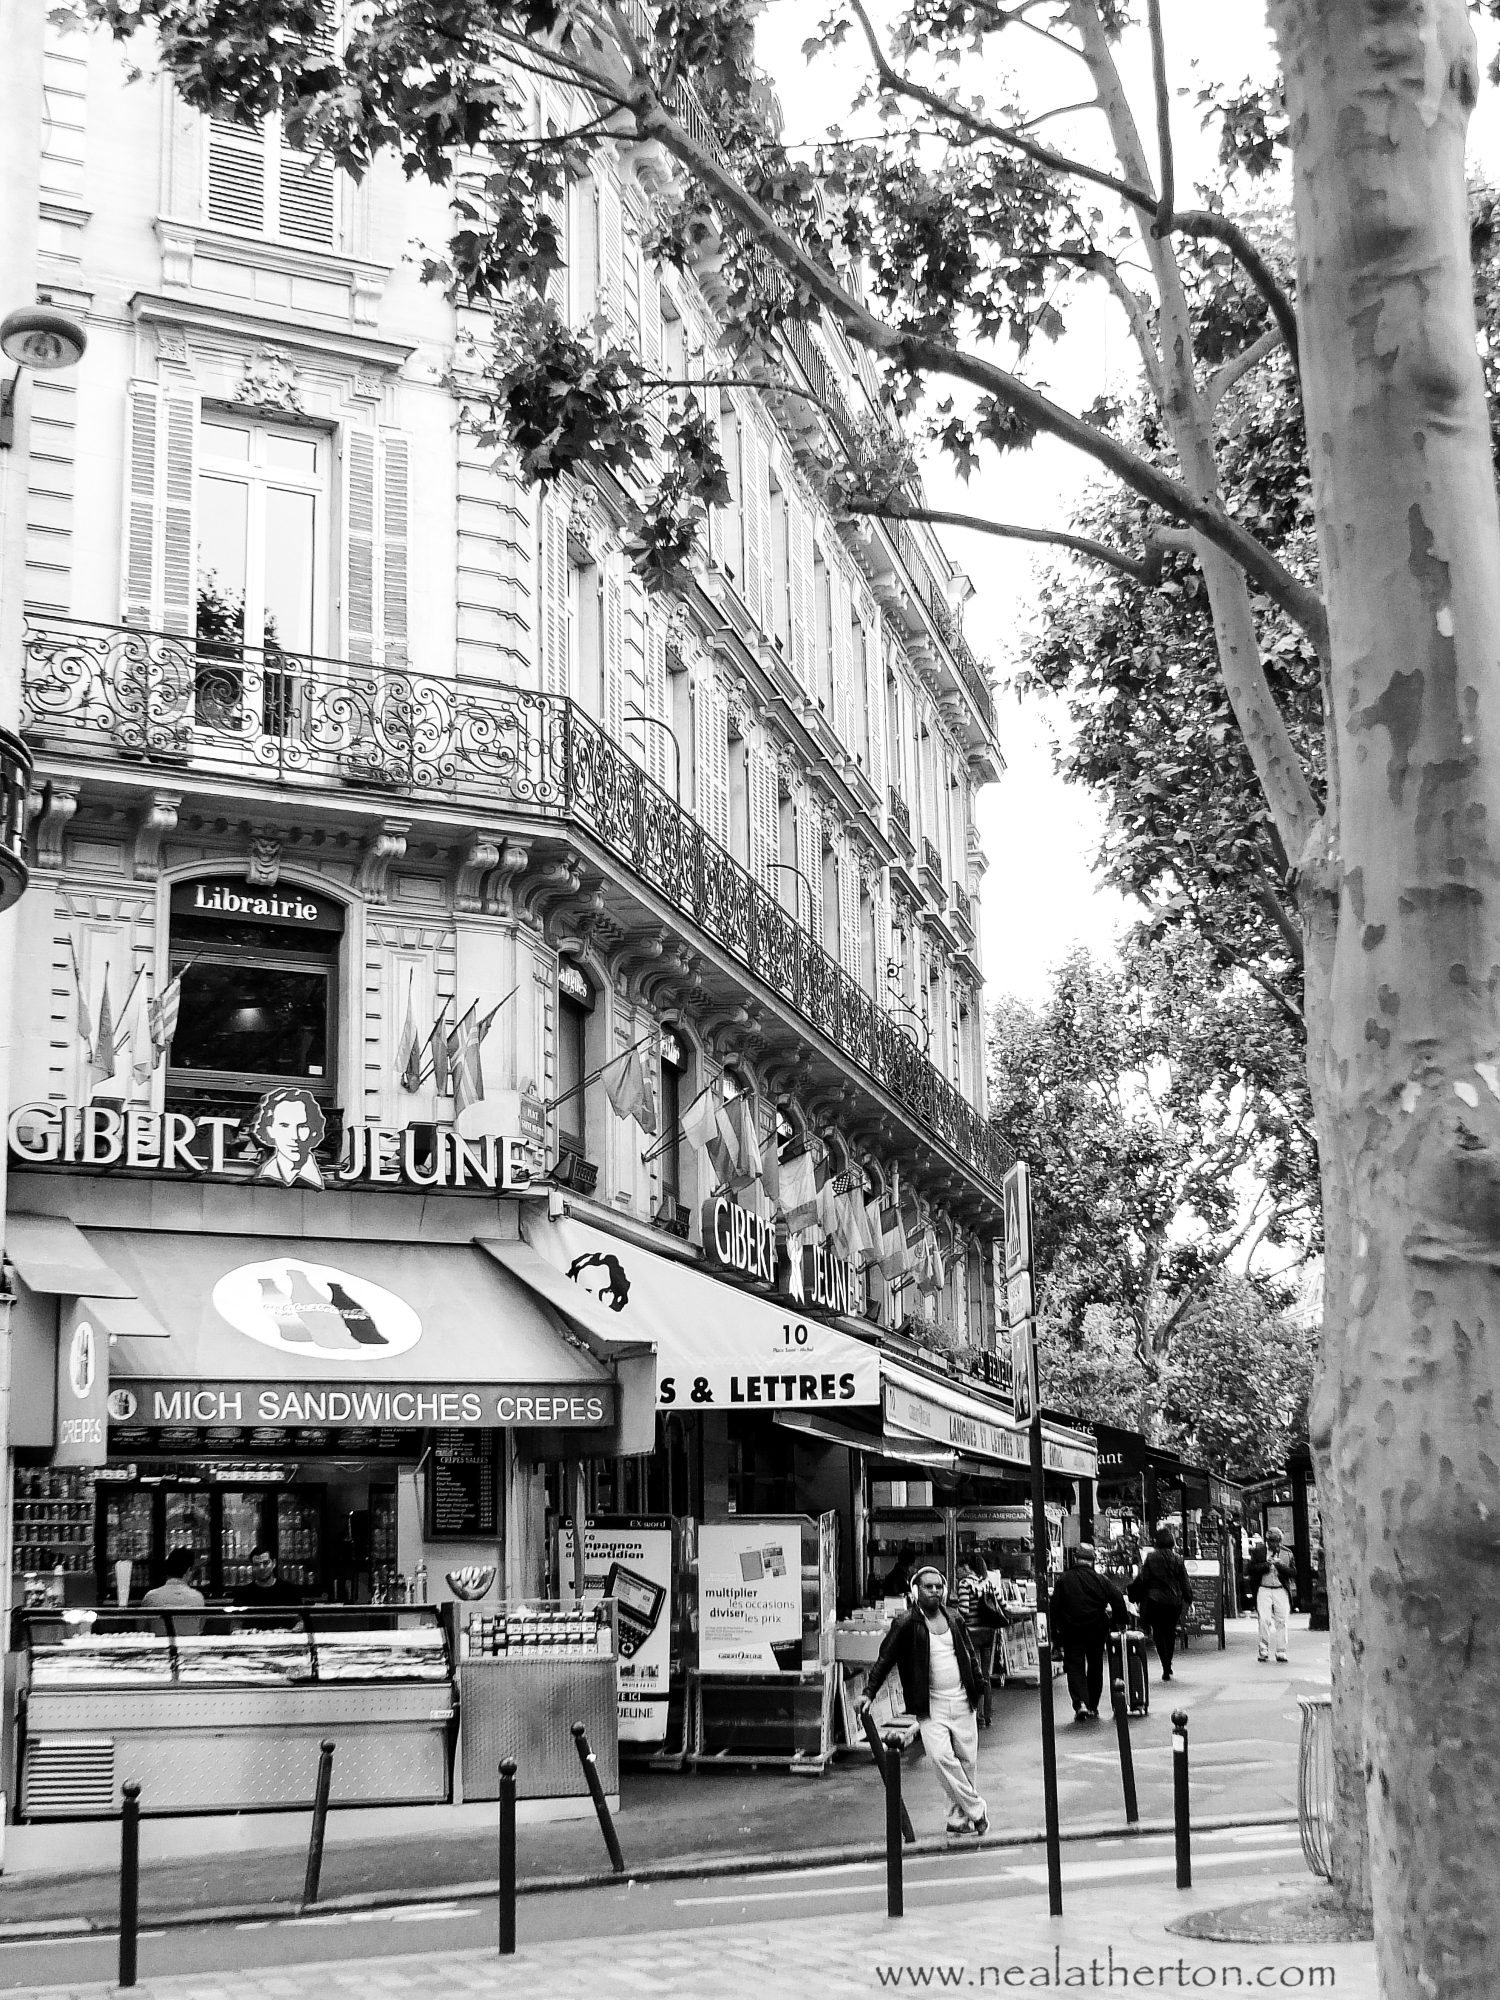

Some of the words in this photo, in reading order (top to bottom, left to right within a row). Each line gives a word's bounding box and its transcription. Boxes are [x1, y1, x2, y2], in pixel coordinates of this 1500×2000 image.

[194, 884, 318, 921] Librairie
[558, 967, 588, 998] angues
[8, 1102, 241, 1174] GIBERT
[340, 1124, 533, 1191] JEUNE
[714, 1196, 776, 1283] GIBERT
[782, 1323, 808, 1345] 10
[690, 1376, 715, 1403] &
[730, 1373, 856, 1403] LETTRES
[153, 1391, 242, 1421] MICH
[257, 1391, 483, 1422] SANDWICHES
[496, 1397, 604, 1421] CREPES
[60, 1418, 102, 1445] CREPES
[565, 1519, 595, 1527] CIO
[565, 1531, 595, 1541] Vre
[565, 1542, 642, 1551] cpagnon
[705, 1587, 758, 1600] multiplier
[729, 1599, 743, 1609] les
[745, 1601, 795, 1609] occasions
[709, 1607, 744, 1618] diviser
[744, 1613, 759, 1623] les
[761, 1613, 782, 1627] prix
